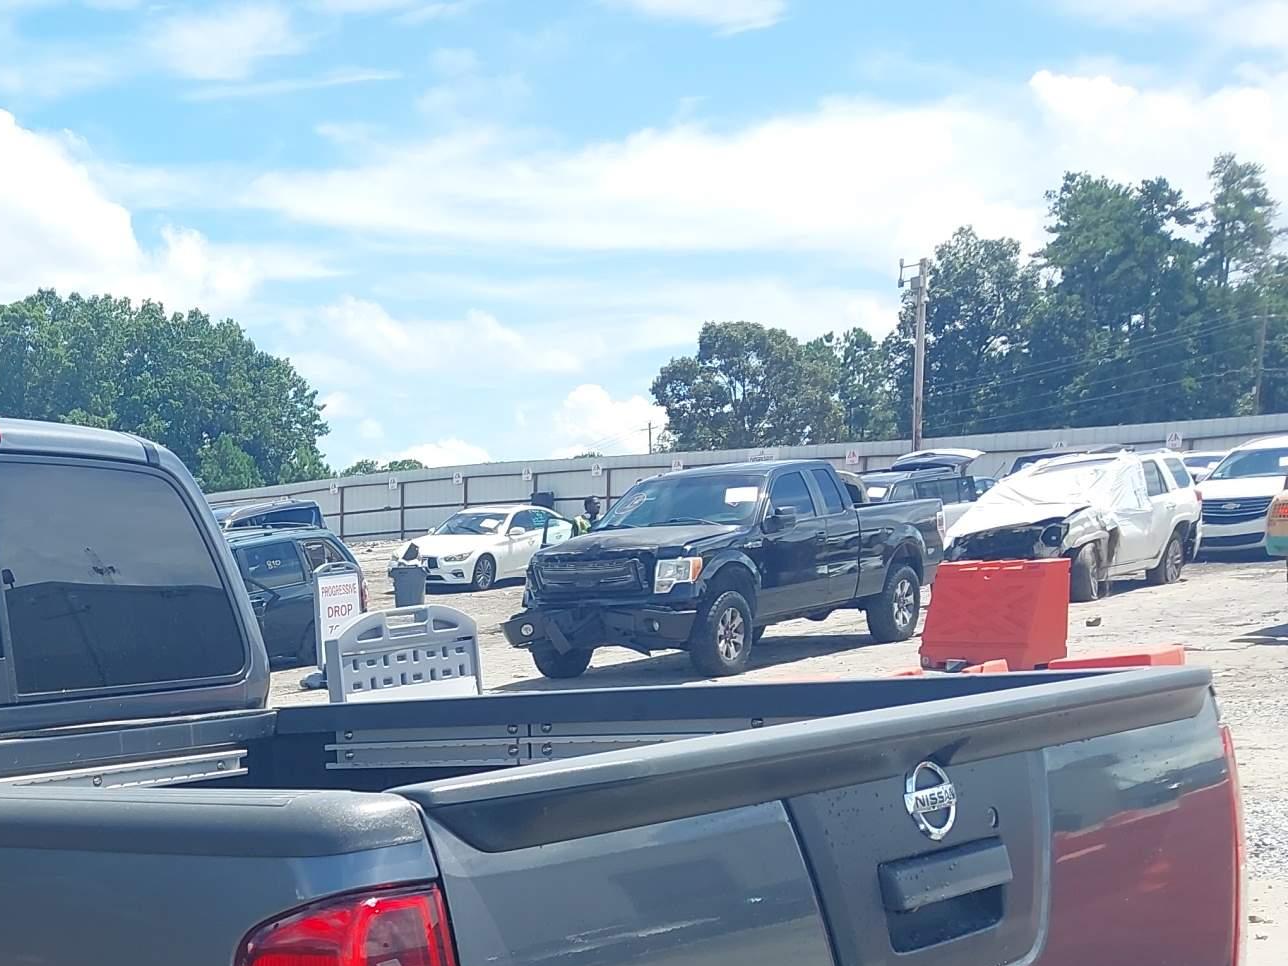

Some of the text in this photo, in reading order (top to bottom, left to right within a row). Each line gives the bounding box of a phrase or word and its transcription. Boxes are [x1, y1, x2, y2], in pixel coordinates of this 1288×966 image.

[321, 583, 358, 597] PROGRESSIVE
[327, 604, 353, 618] DROP
[914, 786, 956, 809] NISSAN
